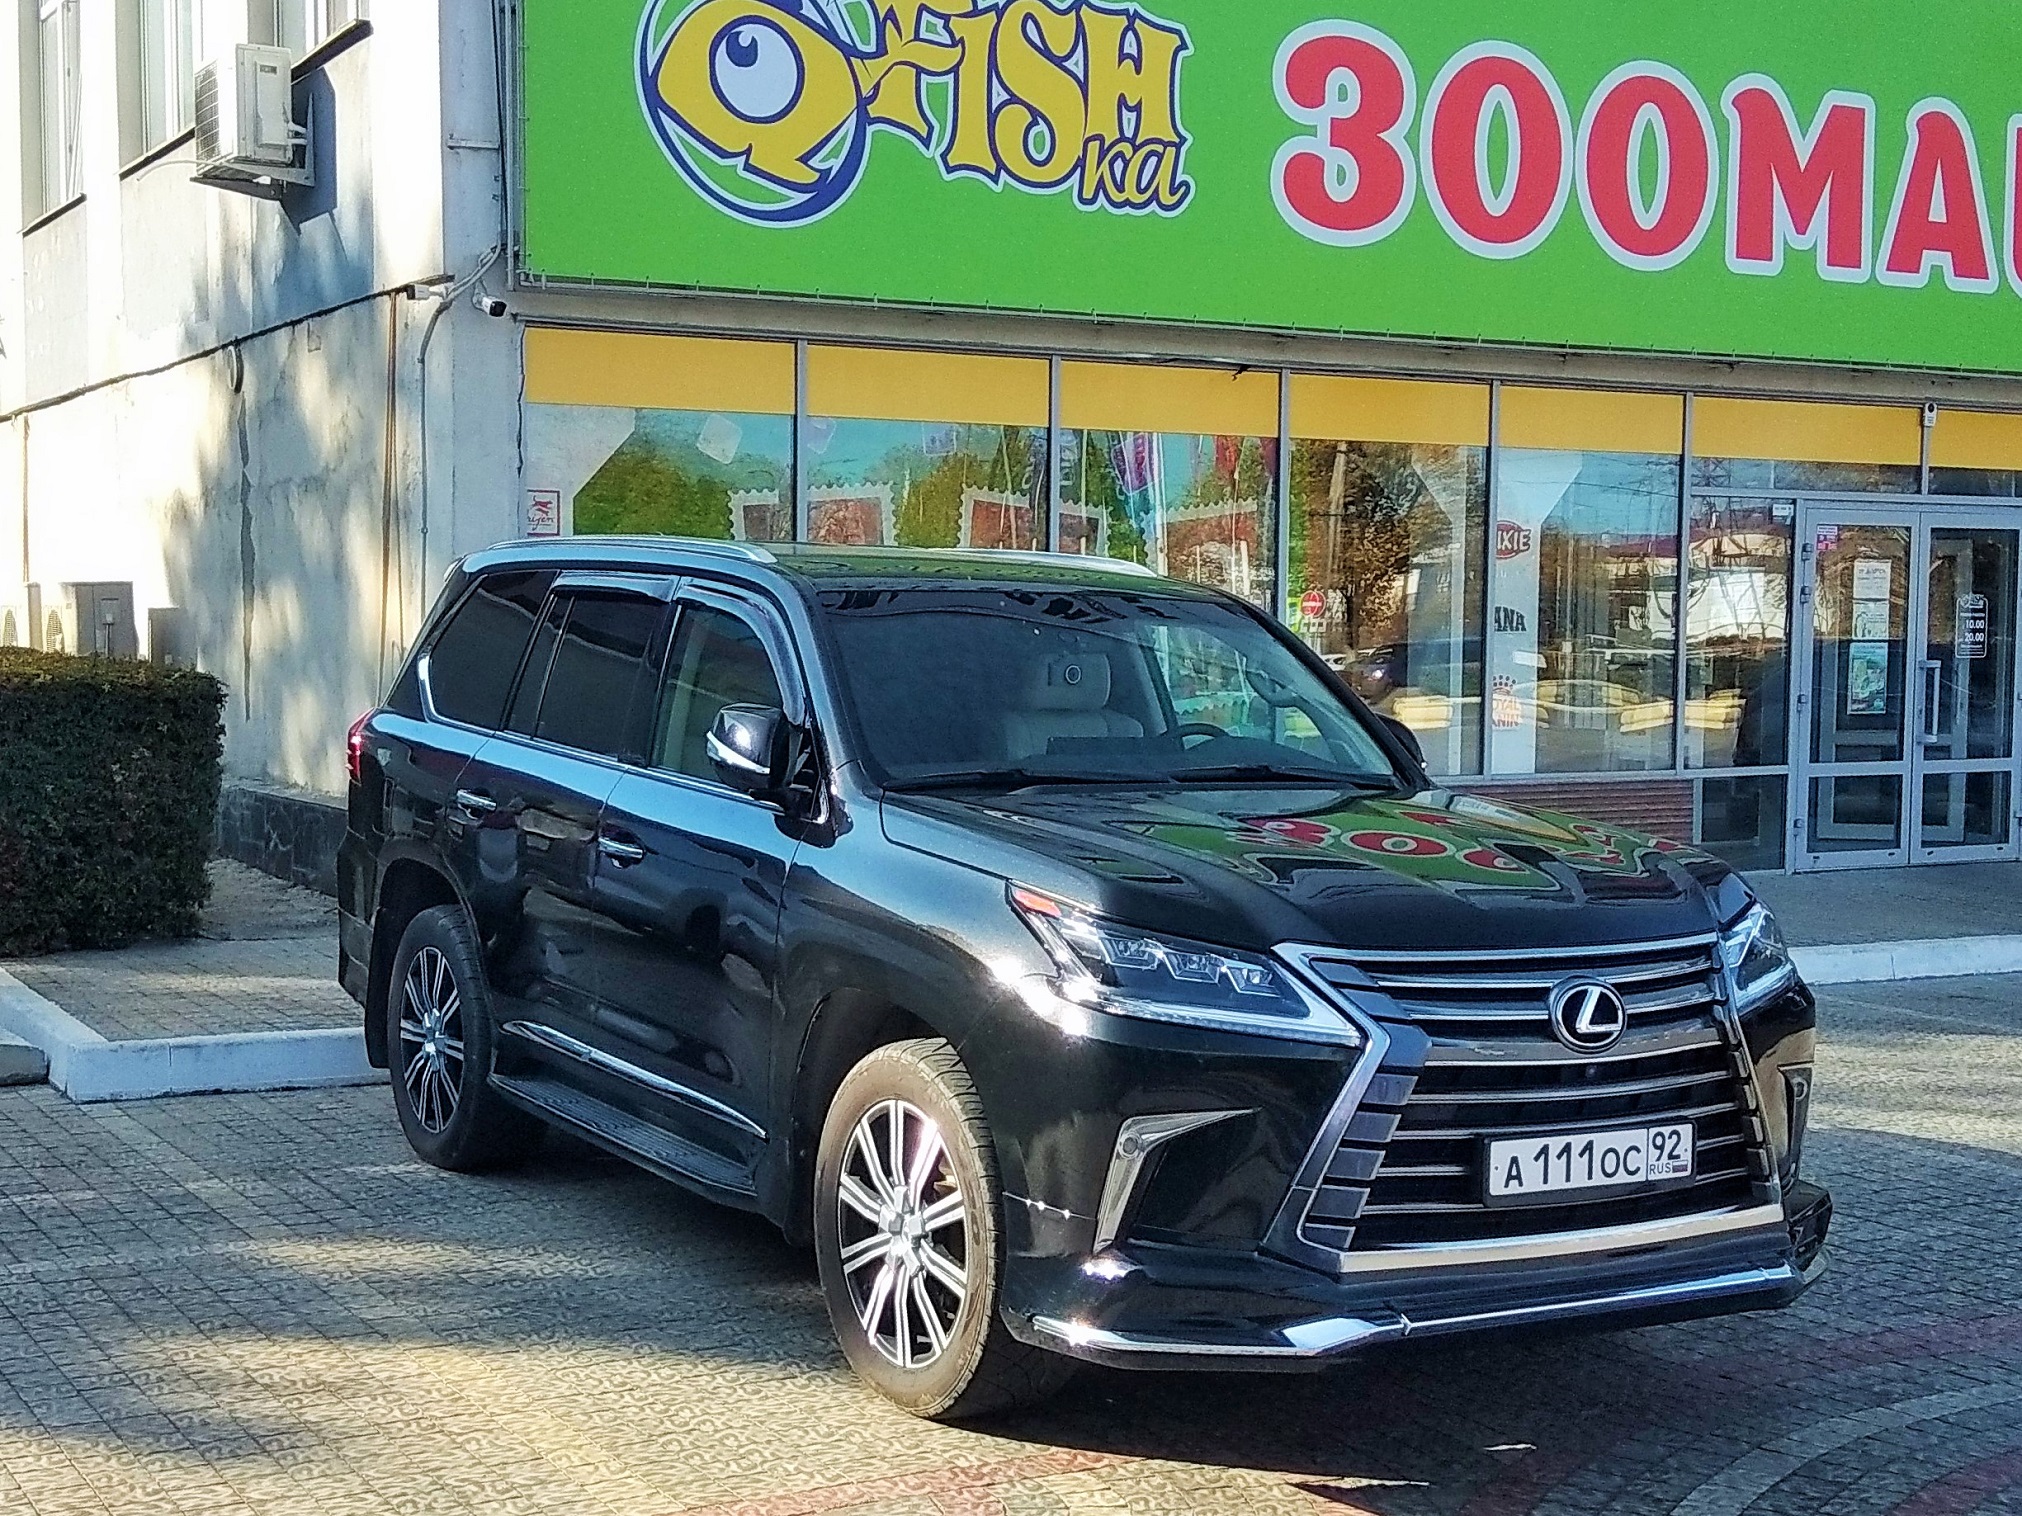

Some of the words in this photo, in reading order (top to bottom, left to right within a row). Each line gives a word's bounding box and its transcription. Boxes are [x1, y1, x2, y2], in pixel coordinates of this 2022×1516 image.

[1276, 28, 2022, 290] ЗООМА
[1651, 1129, 1682, 1162] 92
[1649, 1162, 1672, 1175] RUS
